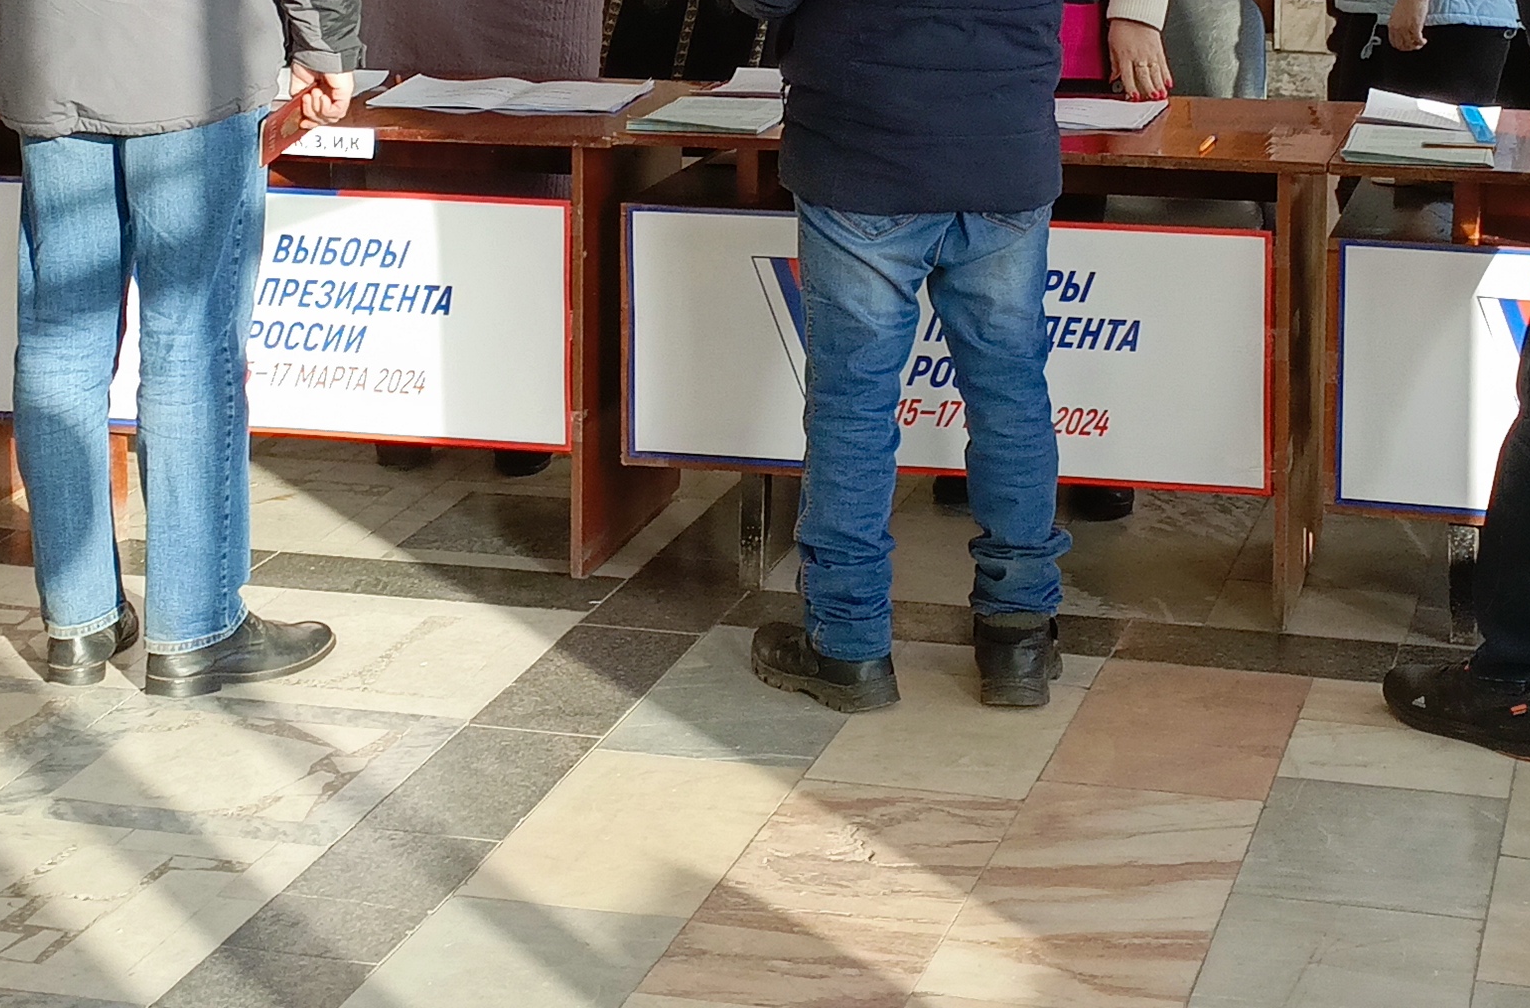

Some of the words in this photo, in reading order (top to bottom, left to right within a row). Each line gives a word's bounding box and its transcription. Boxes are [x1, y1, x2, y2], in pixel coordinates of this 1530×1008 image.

[272, 234, 411, 269] ВЫБОРЫ
[257, 278, 453, 316] ПРЕЗИДЕНТА
[249, 320, 368, 353] РОССИИ
[294, 364, 369, 391] МАРТА
[373, 368, 426, 395] 2024
[1052, 406, 1110, 437] 2024
